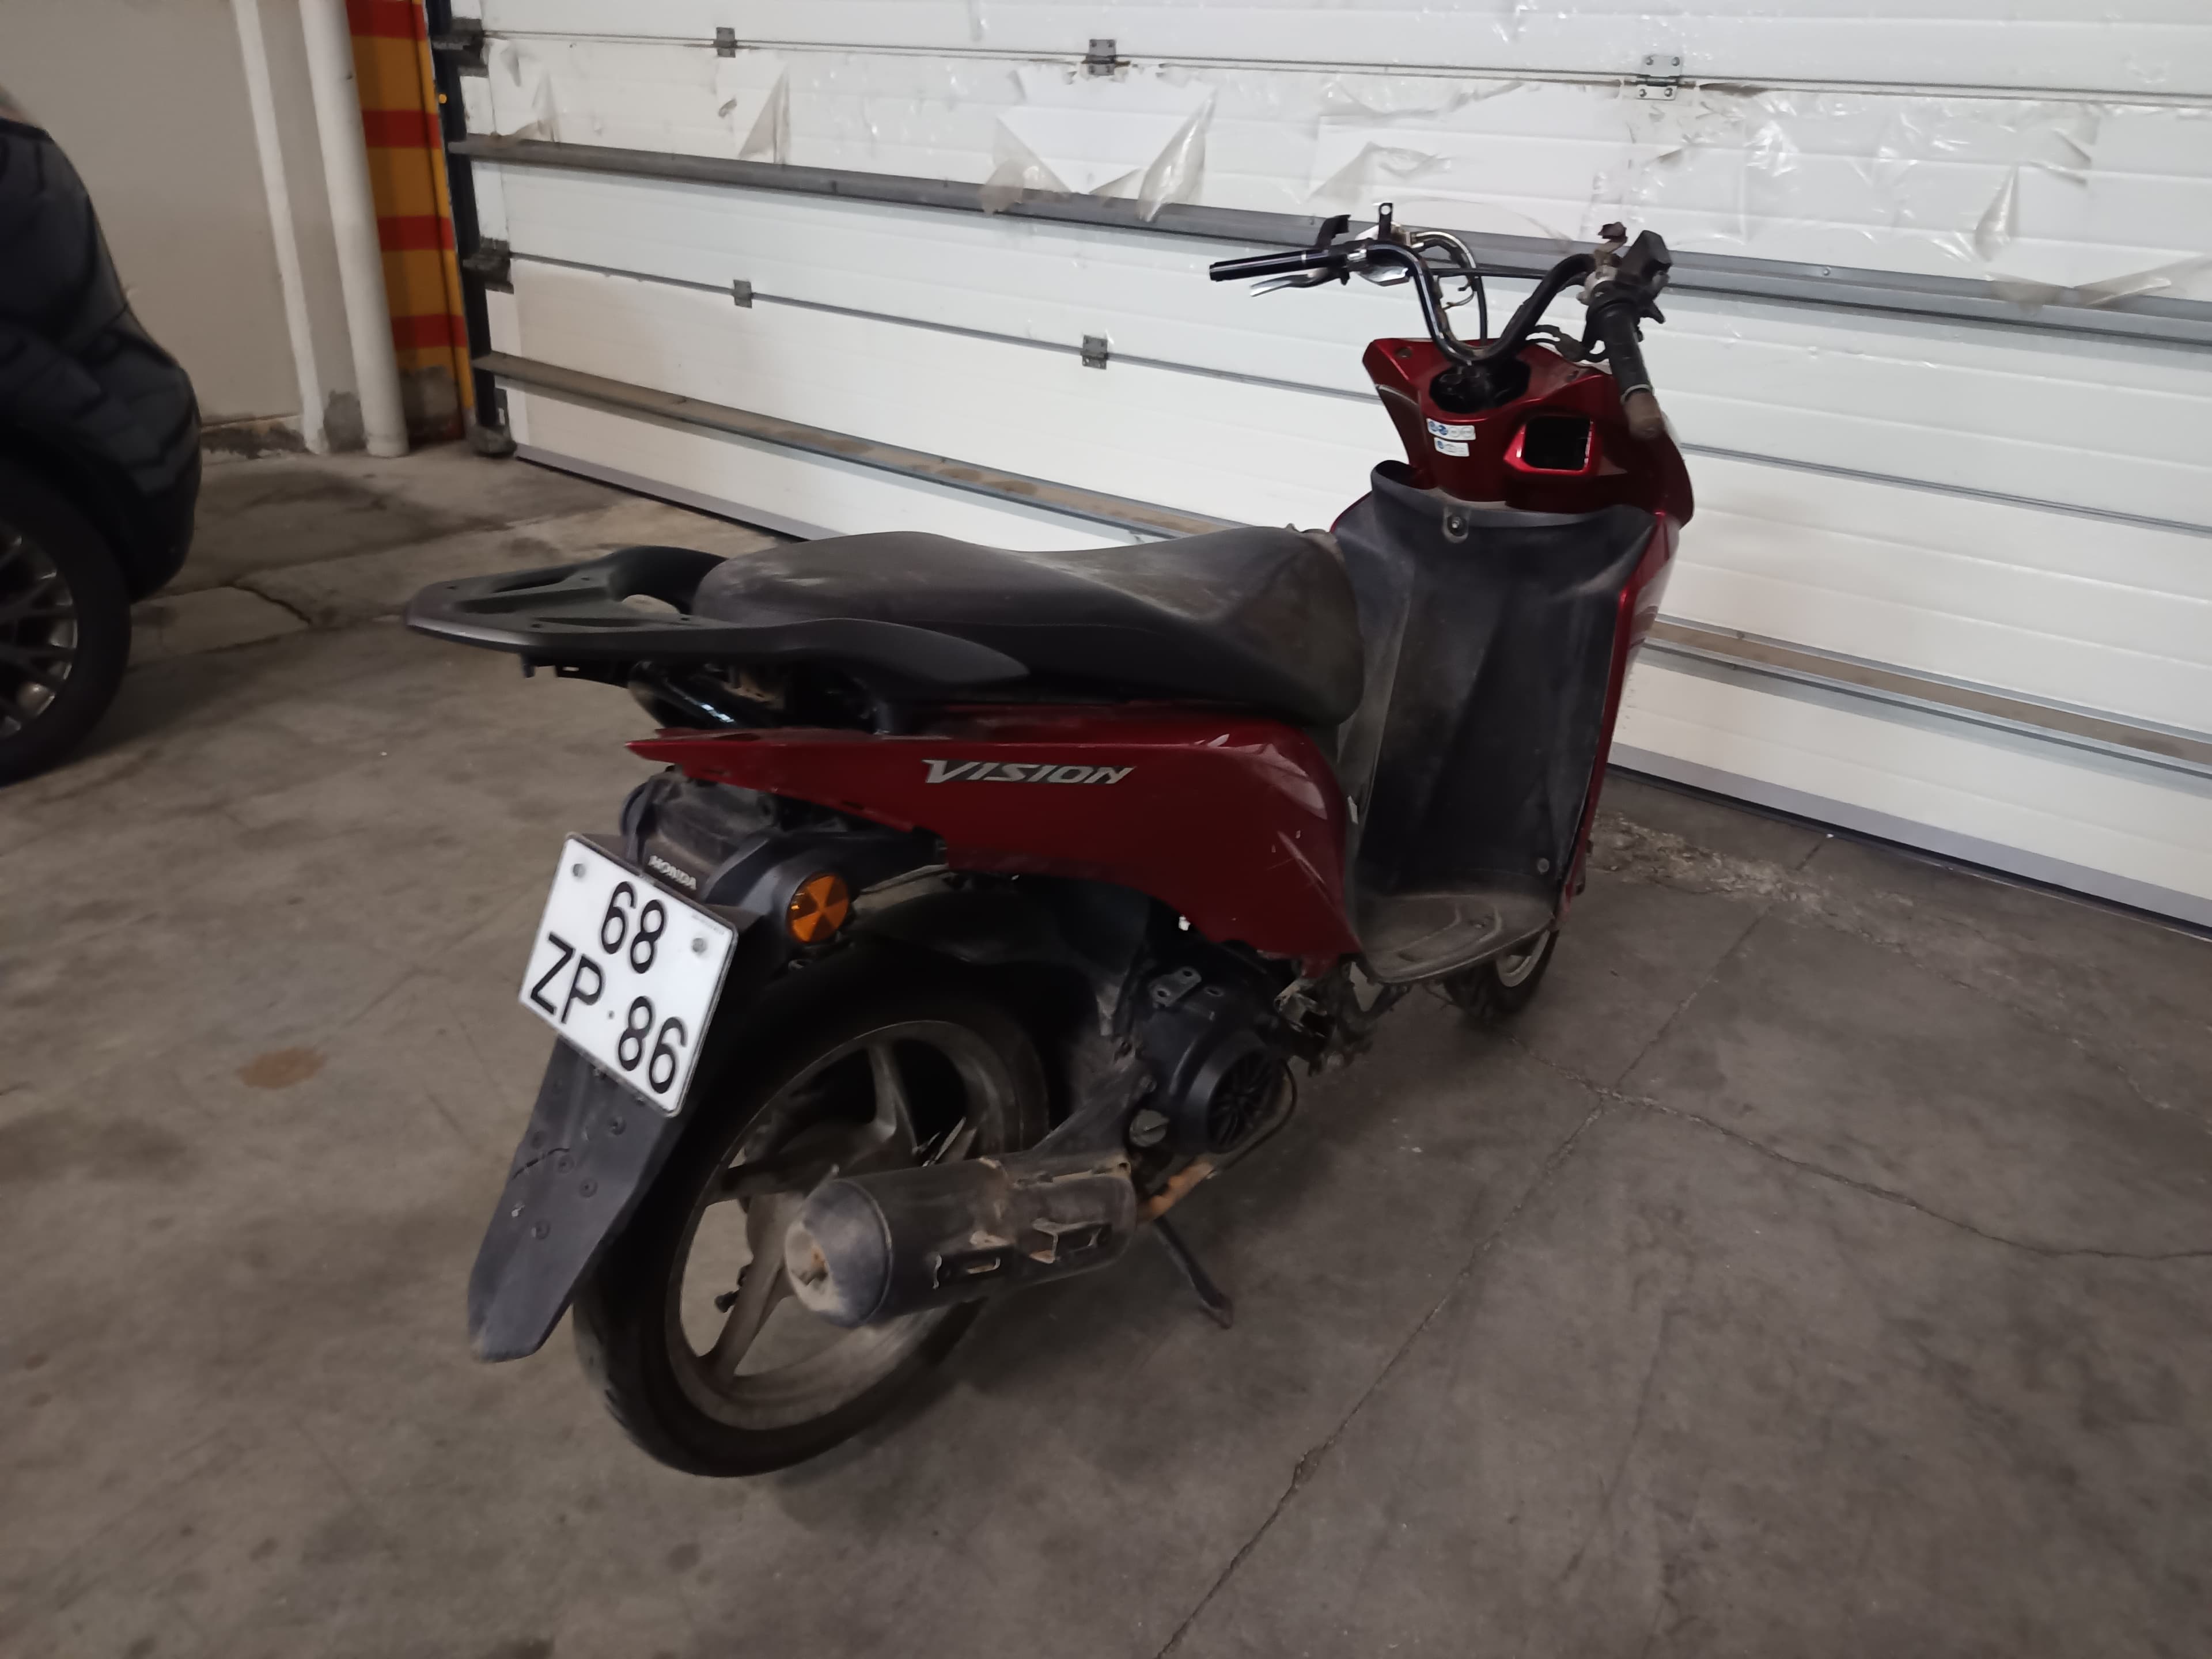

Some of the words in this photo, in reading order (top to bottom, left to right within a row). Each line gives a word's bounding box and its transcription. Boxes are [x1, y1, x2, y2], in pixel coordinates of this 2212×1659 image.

[921, 759, 1137, 784] VISION
[647, 855, 696, 890] HONDA
[601, 881, 666, 974] 68
[530, 931, 605, 1024] ZP
[618, 995, 688, 1094] 86
